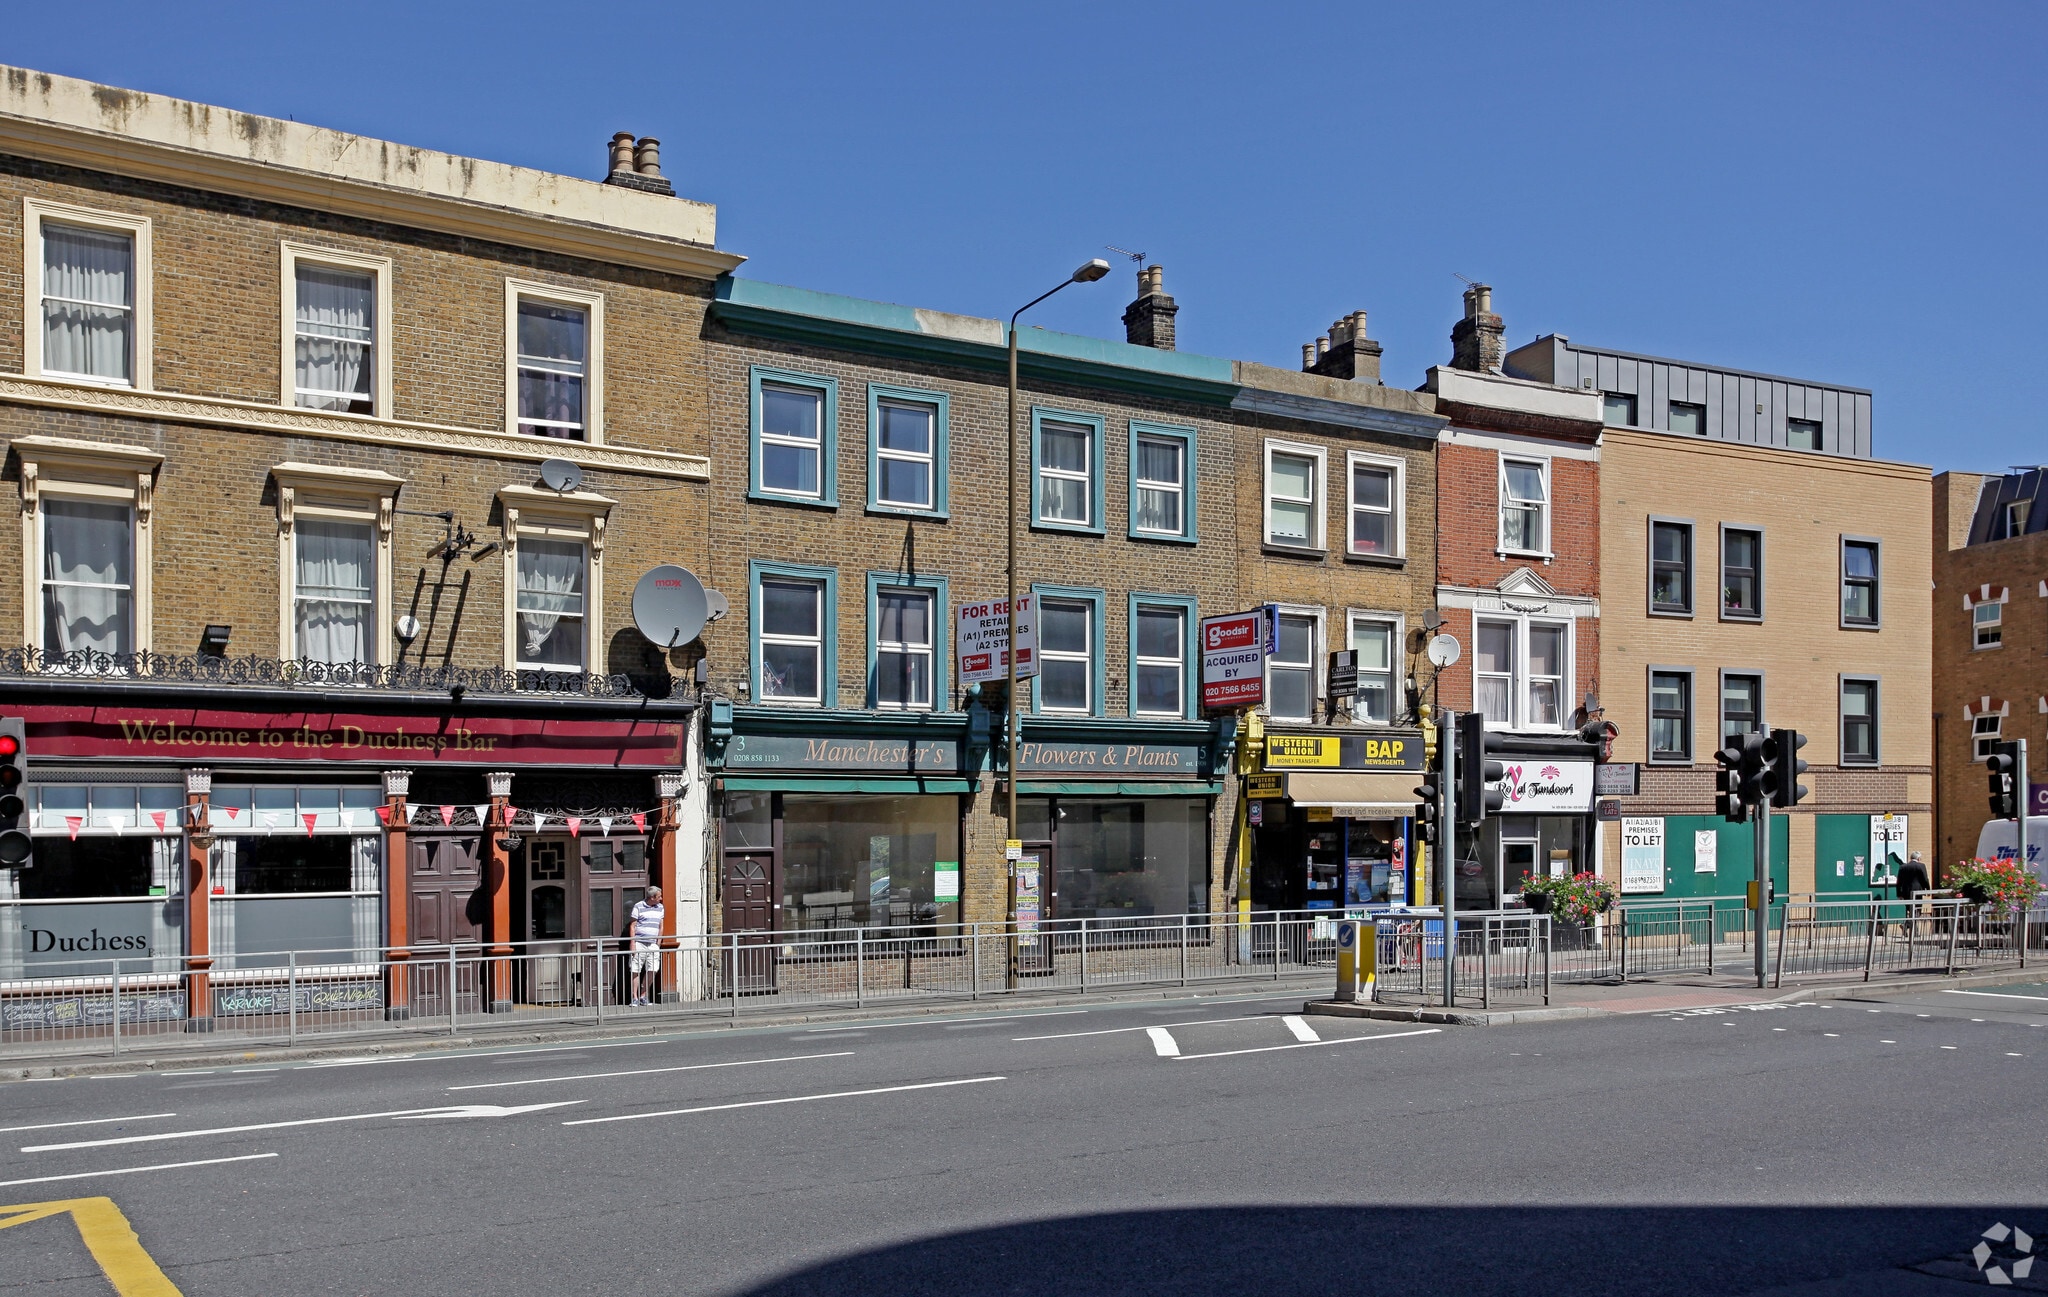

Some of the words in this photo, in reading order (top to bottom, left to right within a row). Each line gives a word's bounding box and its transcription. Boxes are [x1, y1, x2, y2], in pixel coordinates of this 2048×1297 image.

[962, 604, 989, 620] FOR
[980, 616, 1010, 628] RETAI
[963, 631, 981, 643] (A1)
[1209, 624, 1249, 647] goodsir
[975, 641, 991, 652] (A2
[1206, 653, 1259, 668] ACQUIRED
[1225, 668, 1239, 678] BY
[1205, 687, 1219, 697] 020
[1221, 685, 1239, 695] 7566
[1241, 682, 1260, 692] 6455
[118, 719, 250, 747] Welcome
[258, 728, 284, 748] to
[292, 727, 334, 749] the
[340, 725, 447, 752] Duchess
[454, 728, 498, 752] Bar
[737, 736, 746, 751] 3
[1271, 738, 1314, 747] WESTERN
[1366, 740, 1404, 758] BAP
[804, 739, 944, 764] Manchester's
[1020, 743, 1096, 765] Flowers
[1102, 745, 1118, 766] &
[1123, 745, 1180, 767] Plants
[1199, 745, 1207, 760] 5
[1284, 747, 1314, 755] UNION
[733, 754, 750, 762] 0208
[750, 754, 763, 762] 858
[1364, 758, 1406, 766] NEWSAGENTS
[1249, 776, 1276, 784] WESTERN
[1528, 782, 1575, 799] Tandoori
[1368, 807, 1392, 815] receive
[1625, 835, 1640, 846] TO
[1643, 835, 1662, 846] LET
[1888, 831, 1904, 841] LET
[1624, 876, 1641, 884] 01689
[29, 928, 147, 953] Duchess
[220, 996, 273, 1012] KARAOKE
